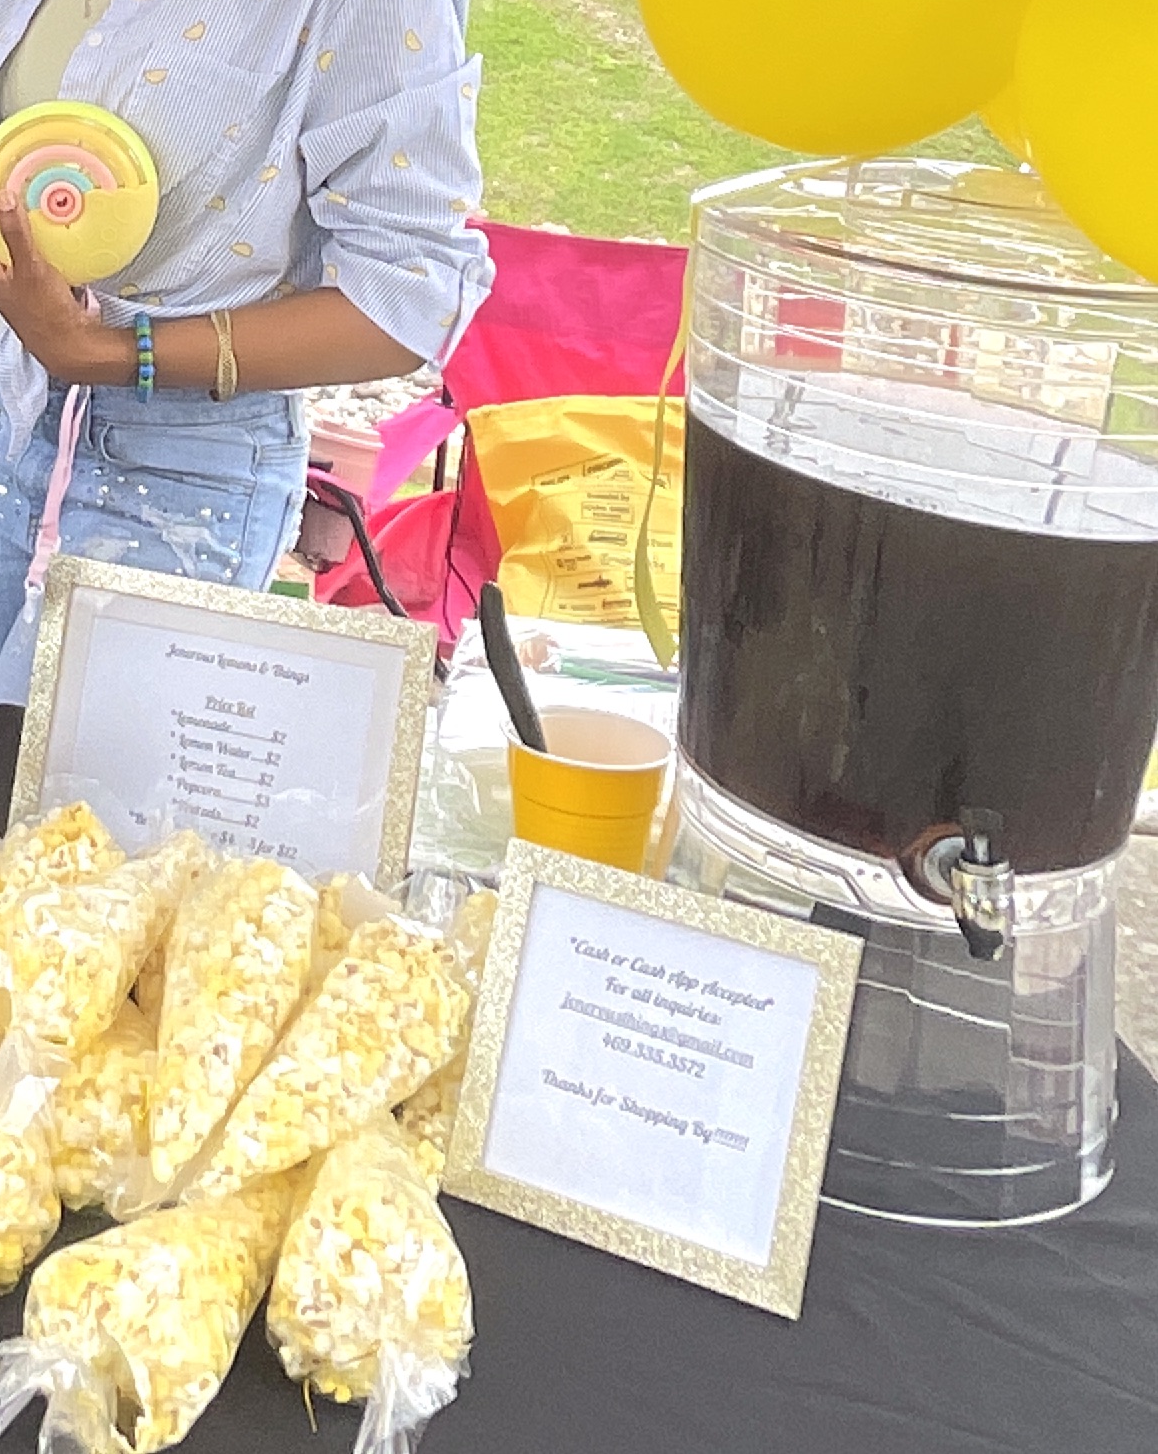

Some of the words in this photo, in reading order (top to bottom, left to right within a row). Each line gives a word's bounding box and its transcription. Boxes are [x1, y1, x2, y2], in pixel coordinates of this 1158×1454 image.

[605, 976, 629, 995] For
[630, 988, 653, 1003] all
[611, 954, 629, 966] or
[630, 957, 665, 979] Cash
[667, 971, 699, 991] App
[542, 1068, 593, 1099] Thanks
[590, 1086, 617, 1106] for
[619, 1096, 689, 1135] Shopping
